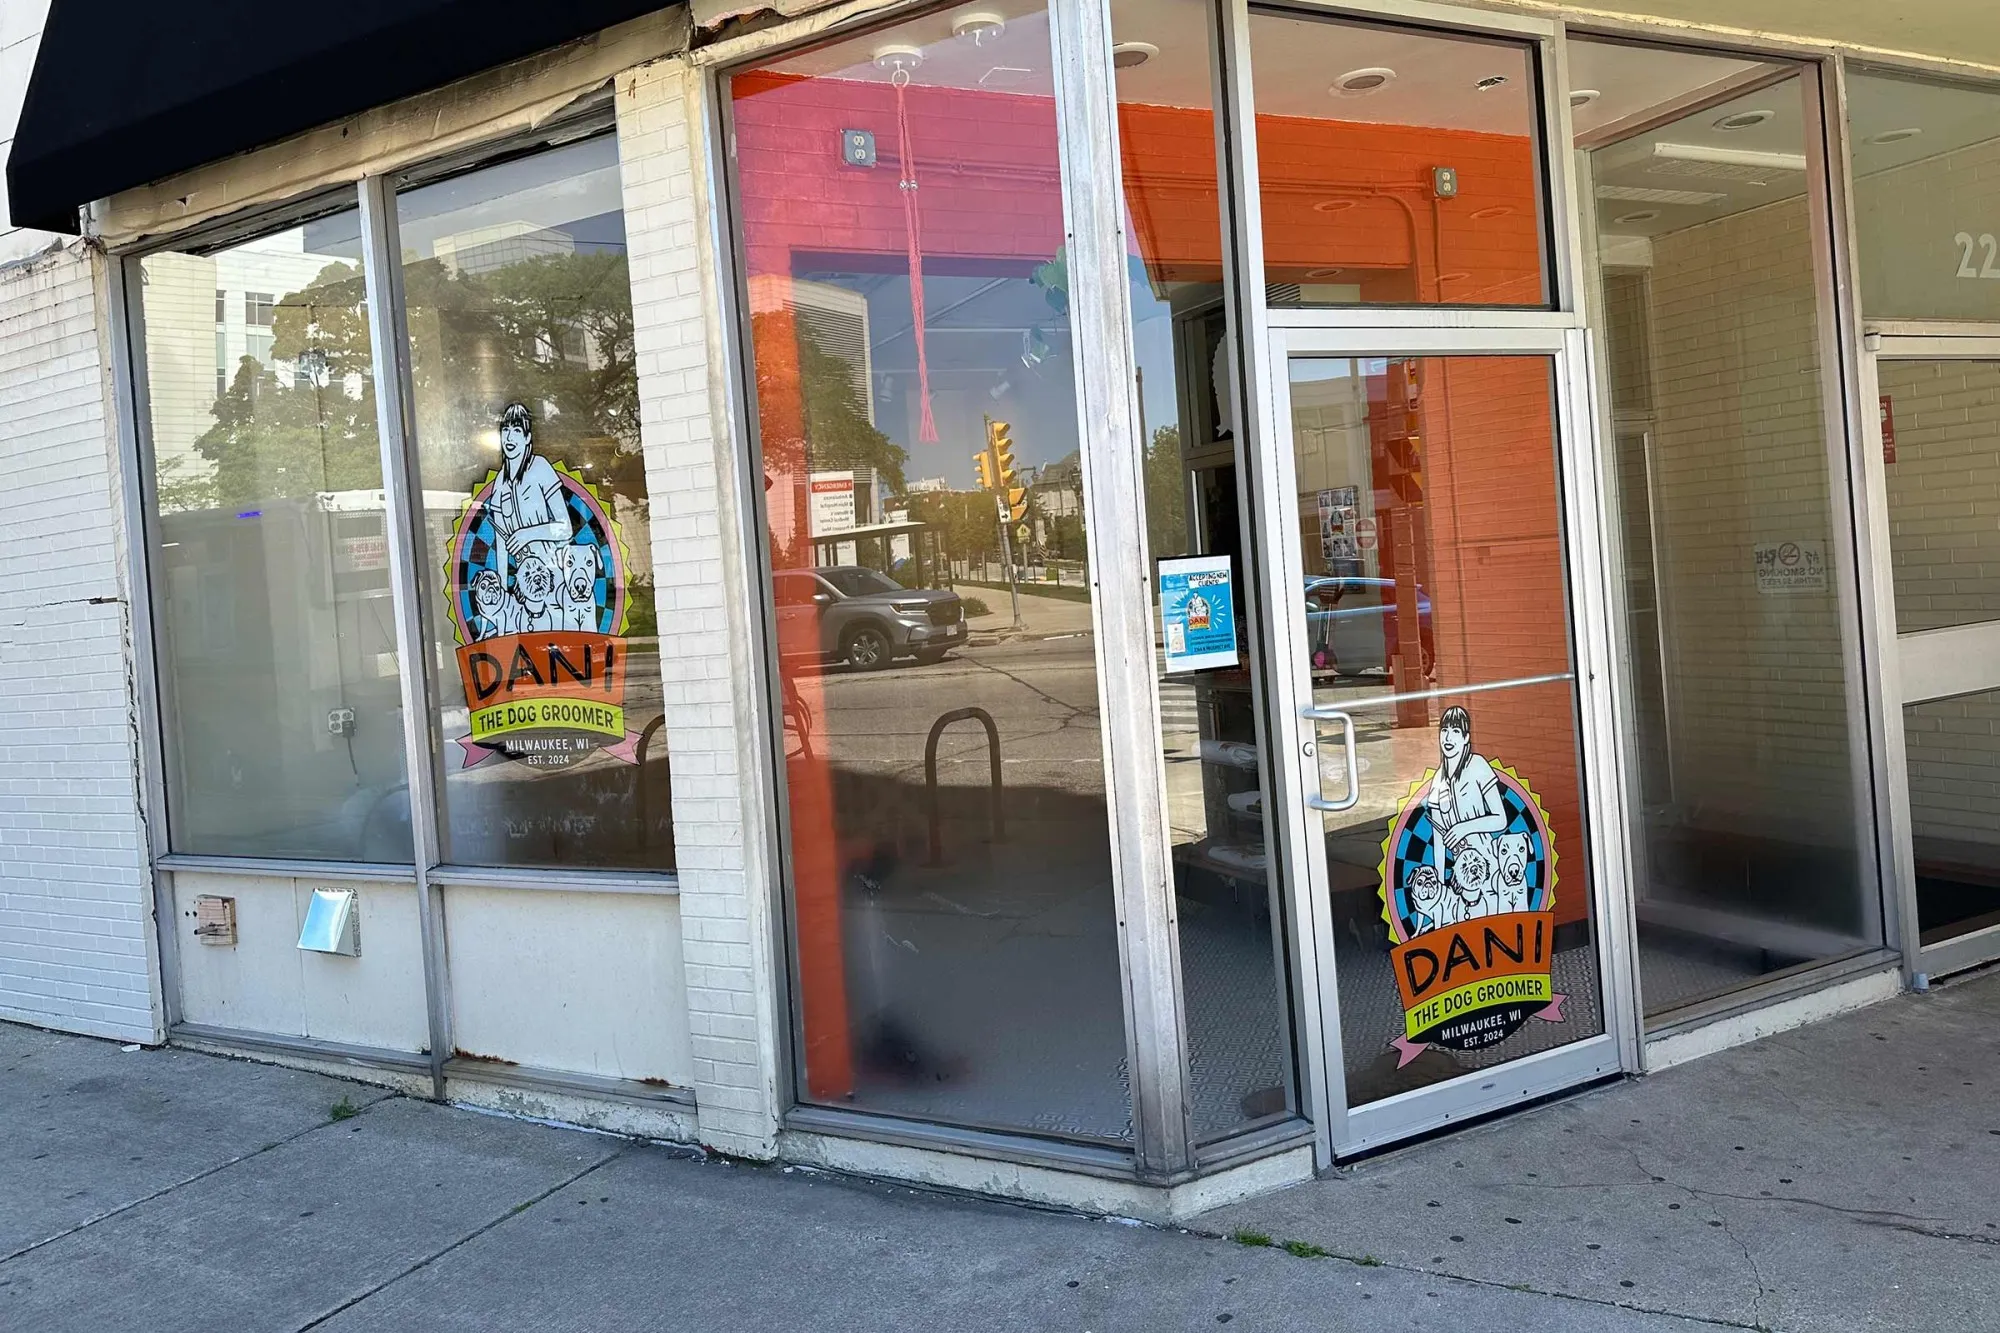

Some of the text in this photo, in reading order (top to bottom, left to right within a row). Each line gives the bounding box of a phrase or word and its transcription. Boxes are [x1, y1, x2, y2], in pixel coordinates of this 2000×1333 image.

[1954, 231, 2000, 279] 22
[1189, 572, 1227, 581] ACCEPTING NEW
[1189, 617, 1209, 625] DANI
[469, 642, 614, 700] DANI
[479, 705, 614, 732] THE DOG GROOMER
[505, 738, 589, 751] MILWAUKEE, WI
[528, 755, 570, 765] EST. 2024
[1404, 920, 1543, 997] DANI
[1414, 979, 1543, 1028] THE DOG GROOMER
[1441, 1009, 1522, 1041] MILWAUKEE, WI
[1464, 1029, 1504, 1048] EST. 2024
